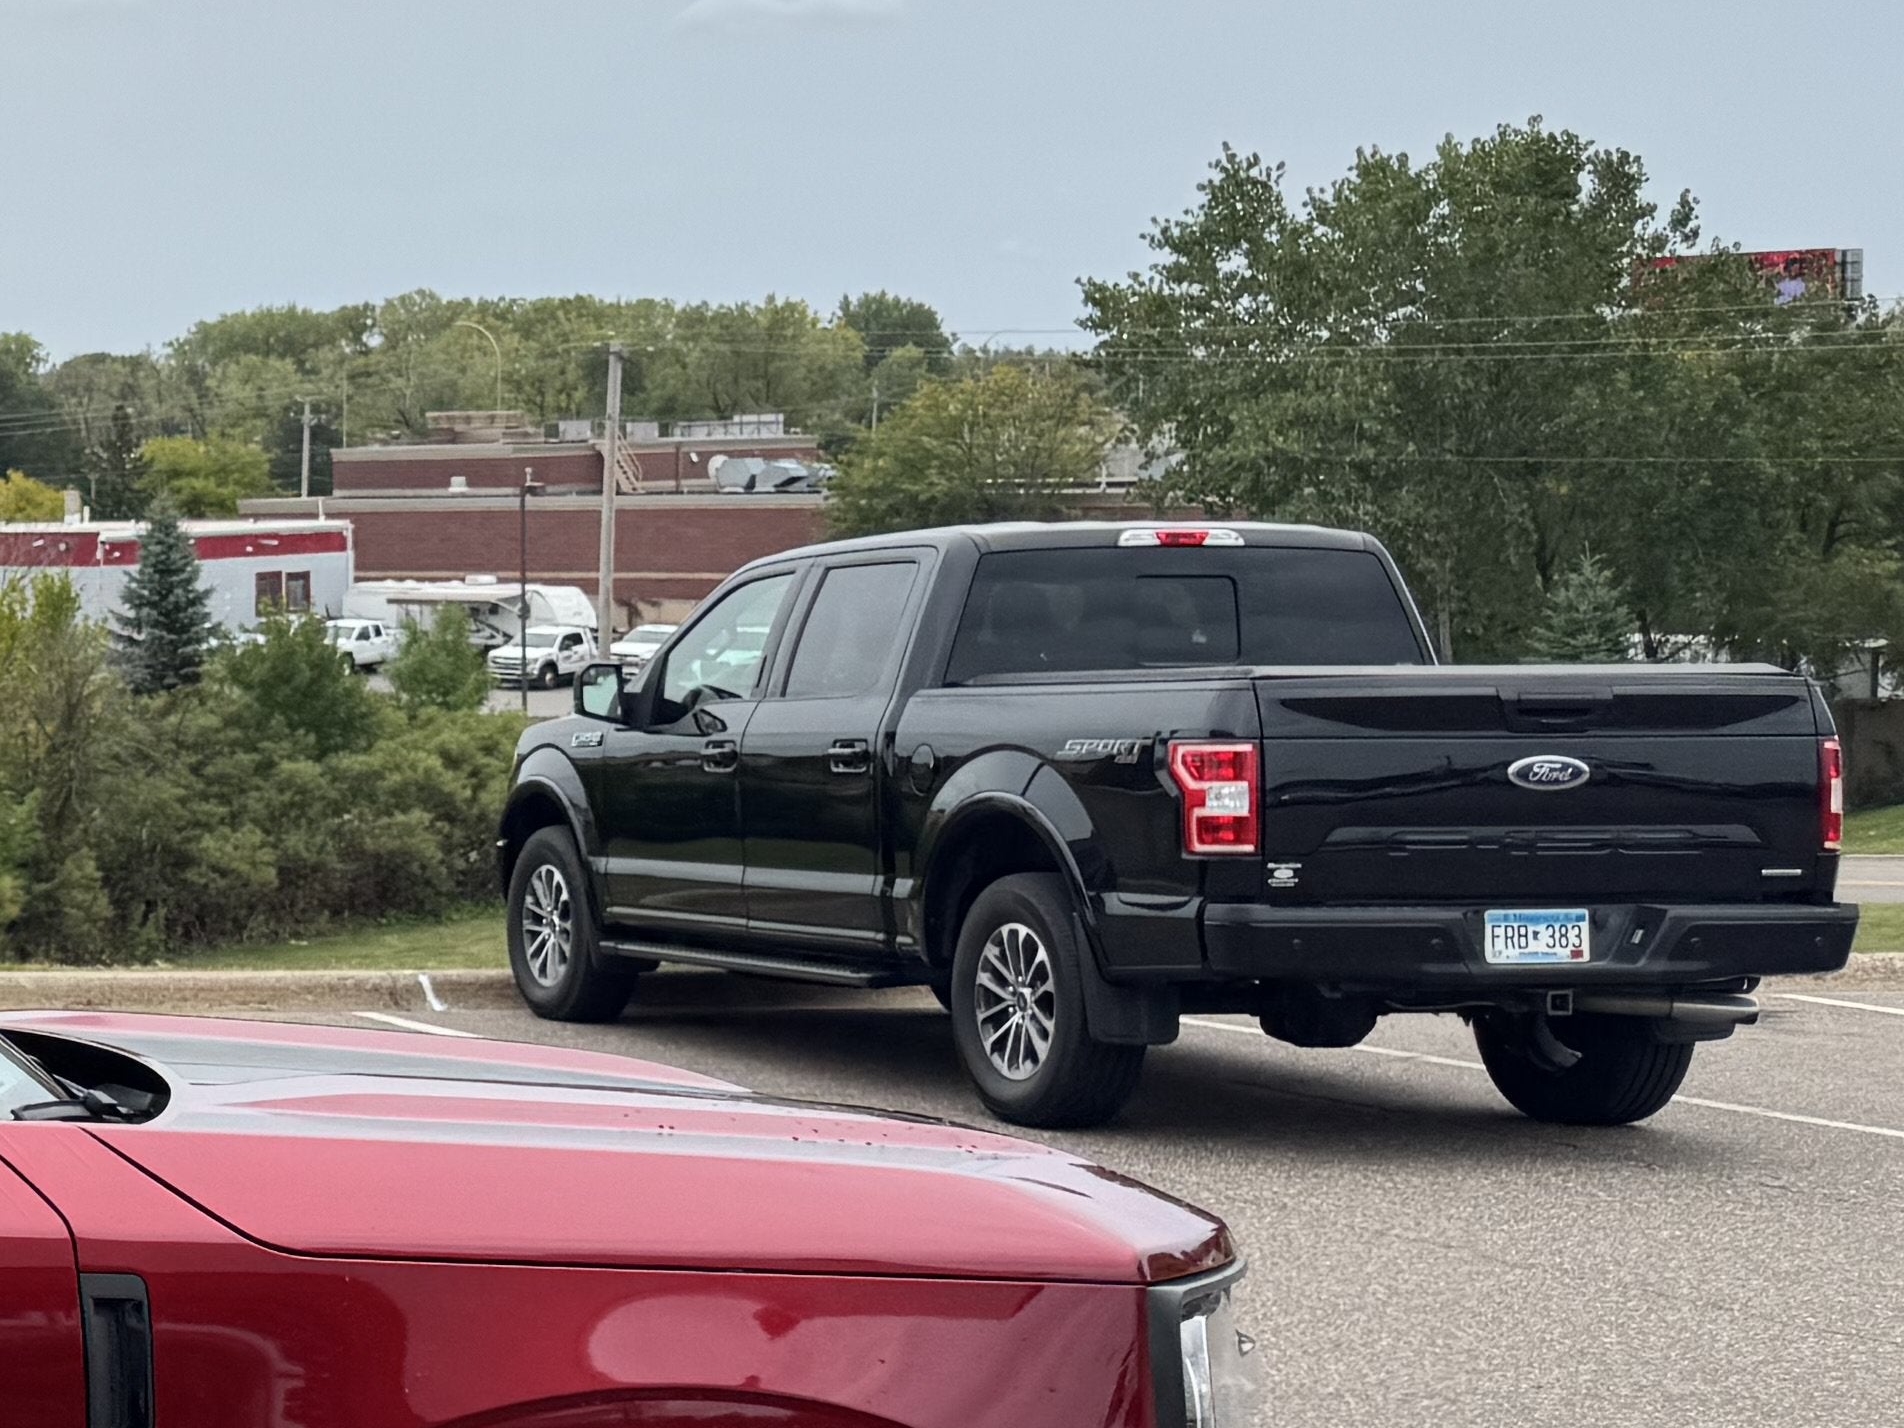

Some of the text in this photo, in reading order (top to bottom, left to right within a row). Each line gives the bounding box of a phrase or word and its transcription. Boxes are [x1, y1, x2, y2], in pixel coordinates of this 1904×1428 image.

[1056, 739, 1153, 755] SPORT
[1491, 924, 1583, 950] FRB 383
